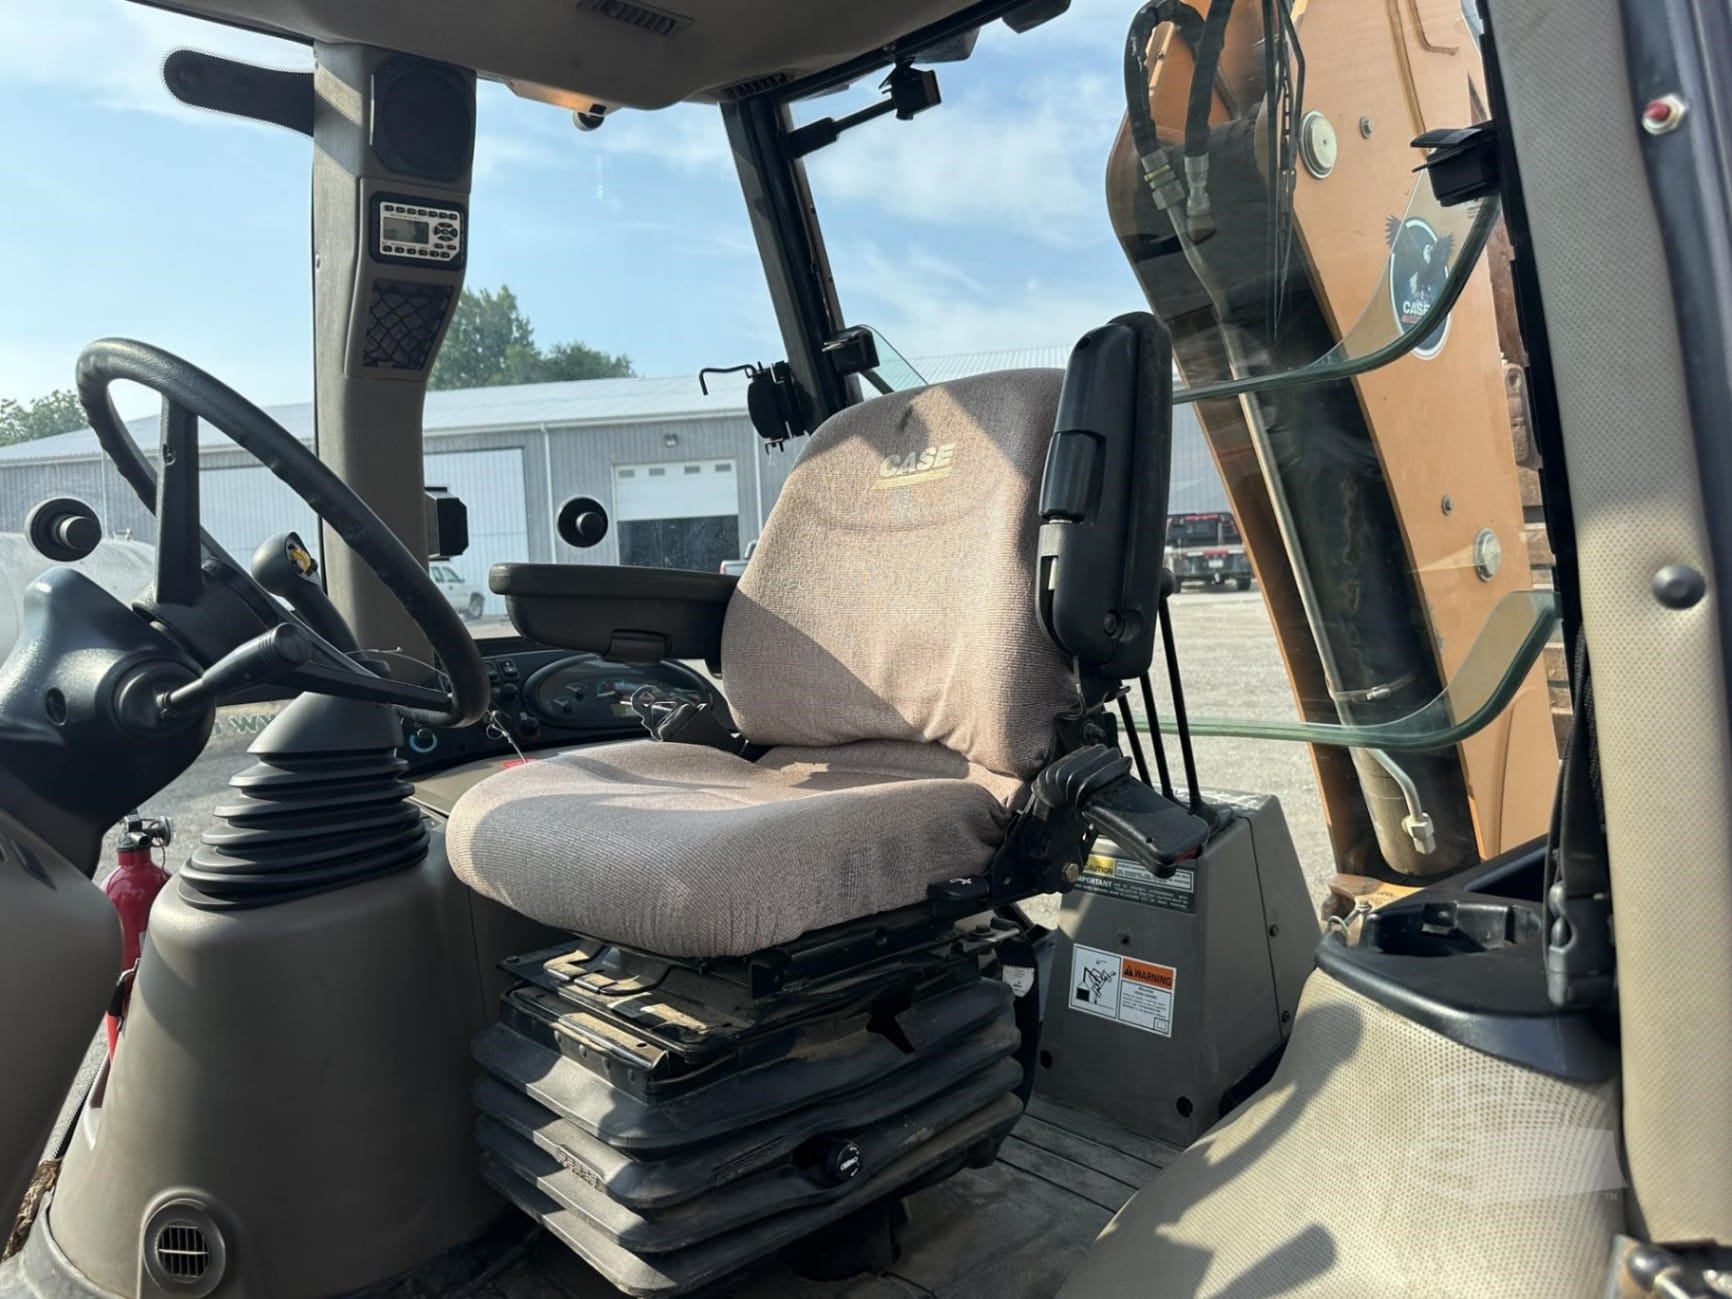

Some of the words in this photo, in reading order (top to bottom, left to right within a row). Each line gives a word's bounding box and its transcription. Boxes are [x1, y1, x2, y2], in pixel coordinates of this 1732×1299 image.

[1403, 300, 1431, 317] CASE
[879, 443, 956, 478] CASE
[1134, 968, 1172, 987] WARNING
